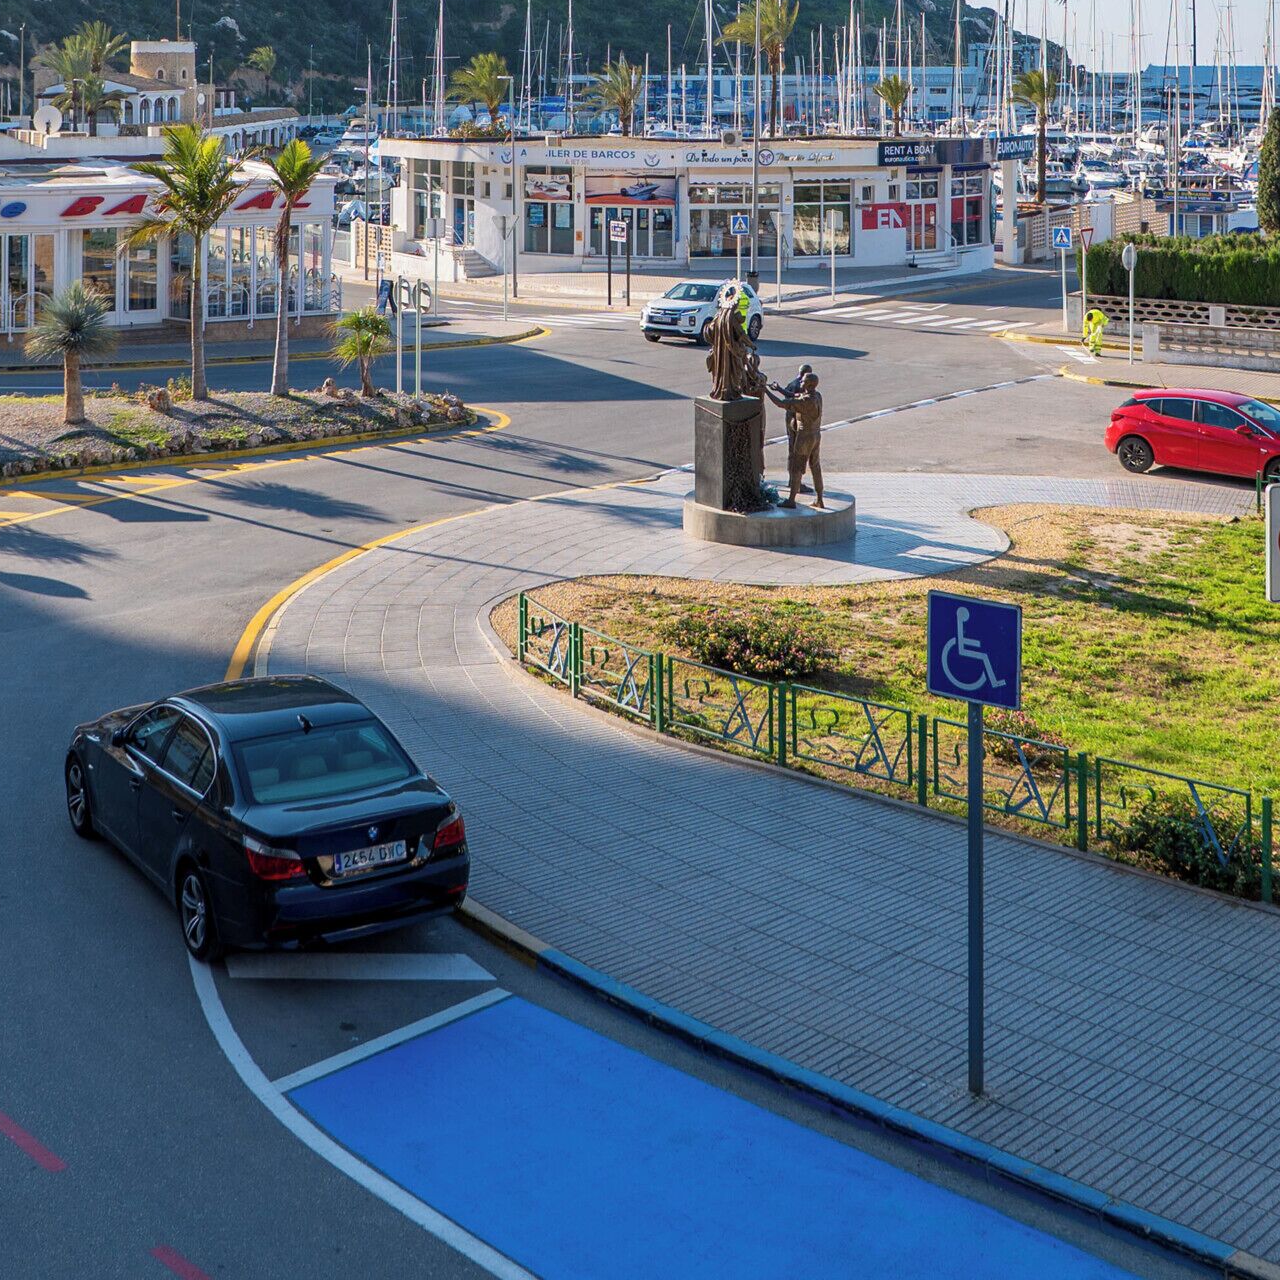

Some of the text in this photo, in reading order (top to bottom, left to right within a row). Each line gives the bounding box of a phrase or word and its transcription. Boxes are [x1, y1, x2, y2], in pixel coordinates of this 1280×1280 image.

[573, 149, 588, 158] DE
[591, 150, 636, 159] BARCOS
[884, 144, 936, 156] RENT A BOAT
[686, 152, 700, 163] De
[732, 155, 753, 165] poco
[884, 155, 927, 163] euronautica.com
[59, 189, 312, 217] BAAL
